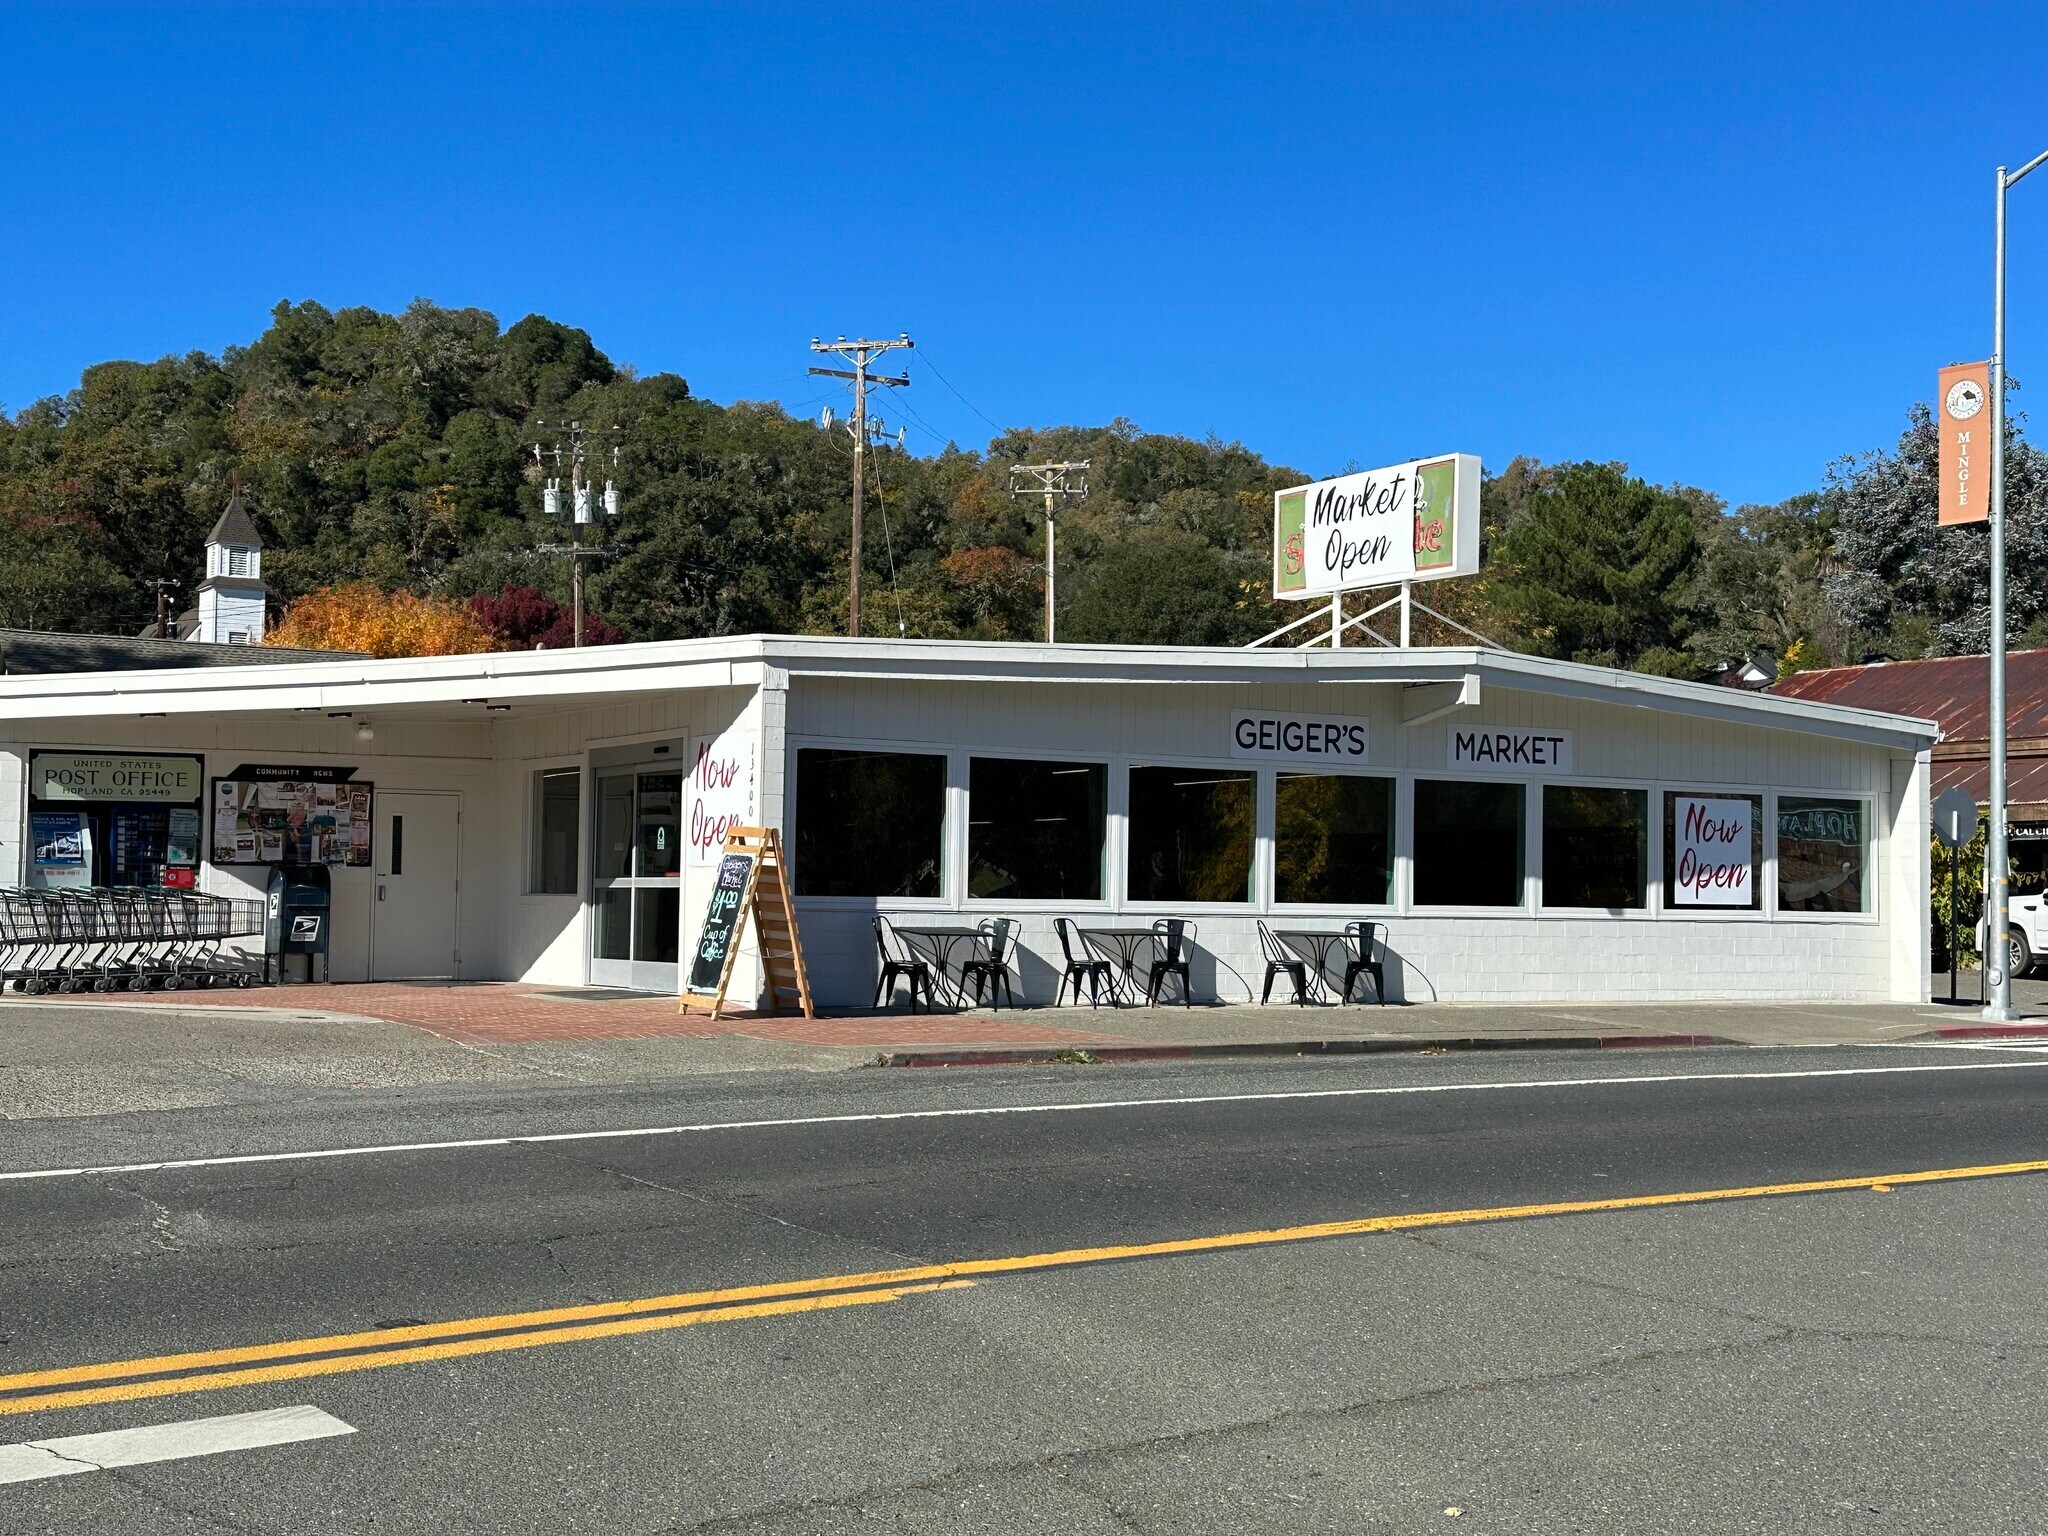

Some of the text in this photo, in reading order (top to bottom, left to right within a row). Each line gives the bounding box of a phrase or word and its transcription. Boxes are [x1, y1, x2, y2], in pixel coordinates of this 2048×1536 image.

[1957, 431, 1971, 506] MINGLE
[1313, 473, 1406, 528] Market
[1325, 528, 1392, 582] Open
[1235, 718, 1365, 755] GEIGER'S
[1455, 731, 1564, 765] MARKET
[45, 769, 188, 787] POST OFFICE
[73, 759, 162, 769] UNITED STATES
[255, 768, 300, 776] COMMUNITY
[696, 742, 740, 792] Now
[62, 787, 171, 797] HOPLAND CA 95449
[1684, 802, 1743, 844] Now
[1679, 847, 1748, 900] Open
[703, 924, 731, 947] Cup of
